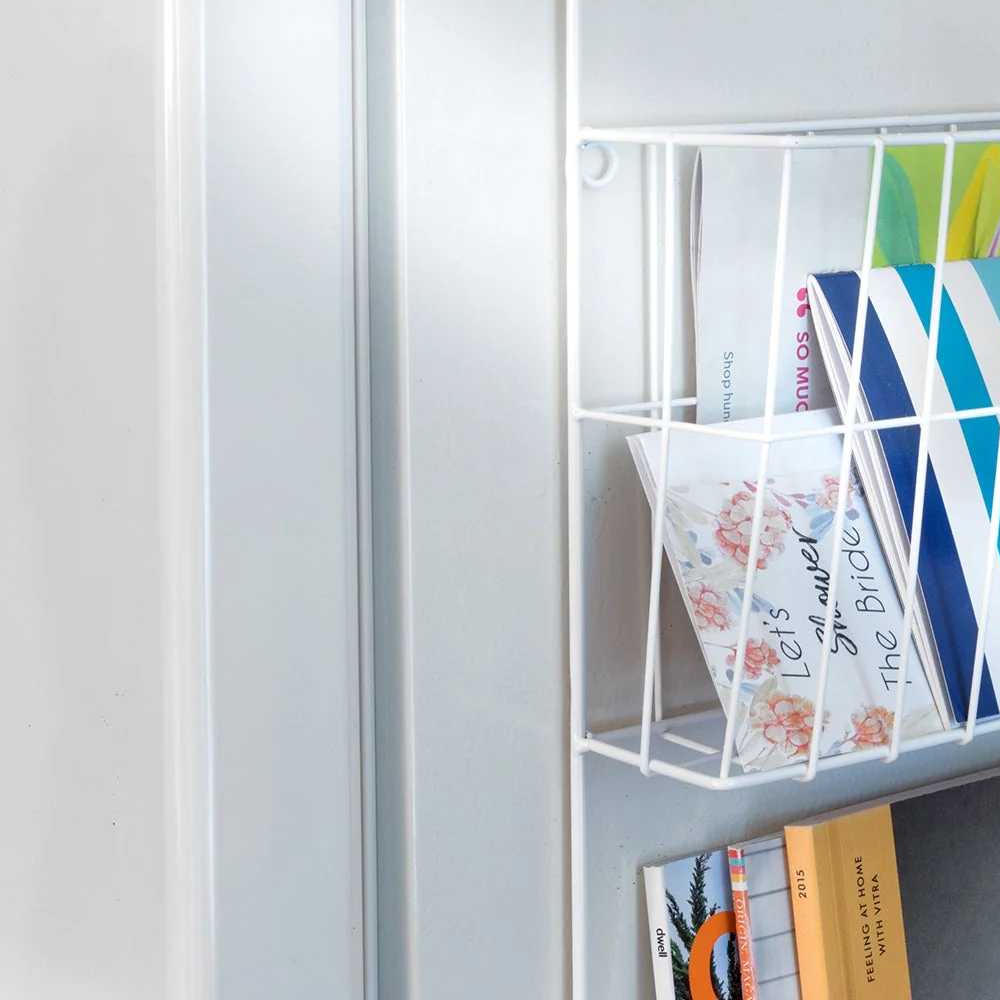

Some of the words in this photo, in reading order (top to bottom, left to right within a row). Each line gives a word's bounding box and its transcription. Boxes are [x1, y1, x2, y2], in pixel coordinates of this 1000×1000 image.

[796, 331, 810, 361] SO
[721, 351, 734, 389] Shop
[723, 392, 734, 422] hun
[841, 526, 886, 613] Bride
[764, 608, 811, 679] Let's
[875, 630, 913, 691] The
[796, 869, 808, 899] 2015
[854, 855, 866, 898] HOME
[870, 873, 882, 915] VITRA
[859, 902, 870, 918] AT
[656, 927, 668, 958] dwell
[861, 924, 876, 983] FEELING
[874, 919, 886, 957] WITH
